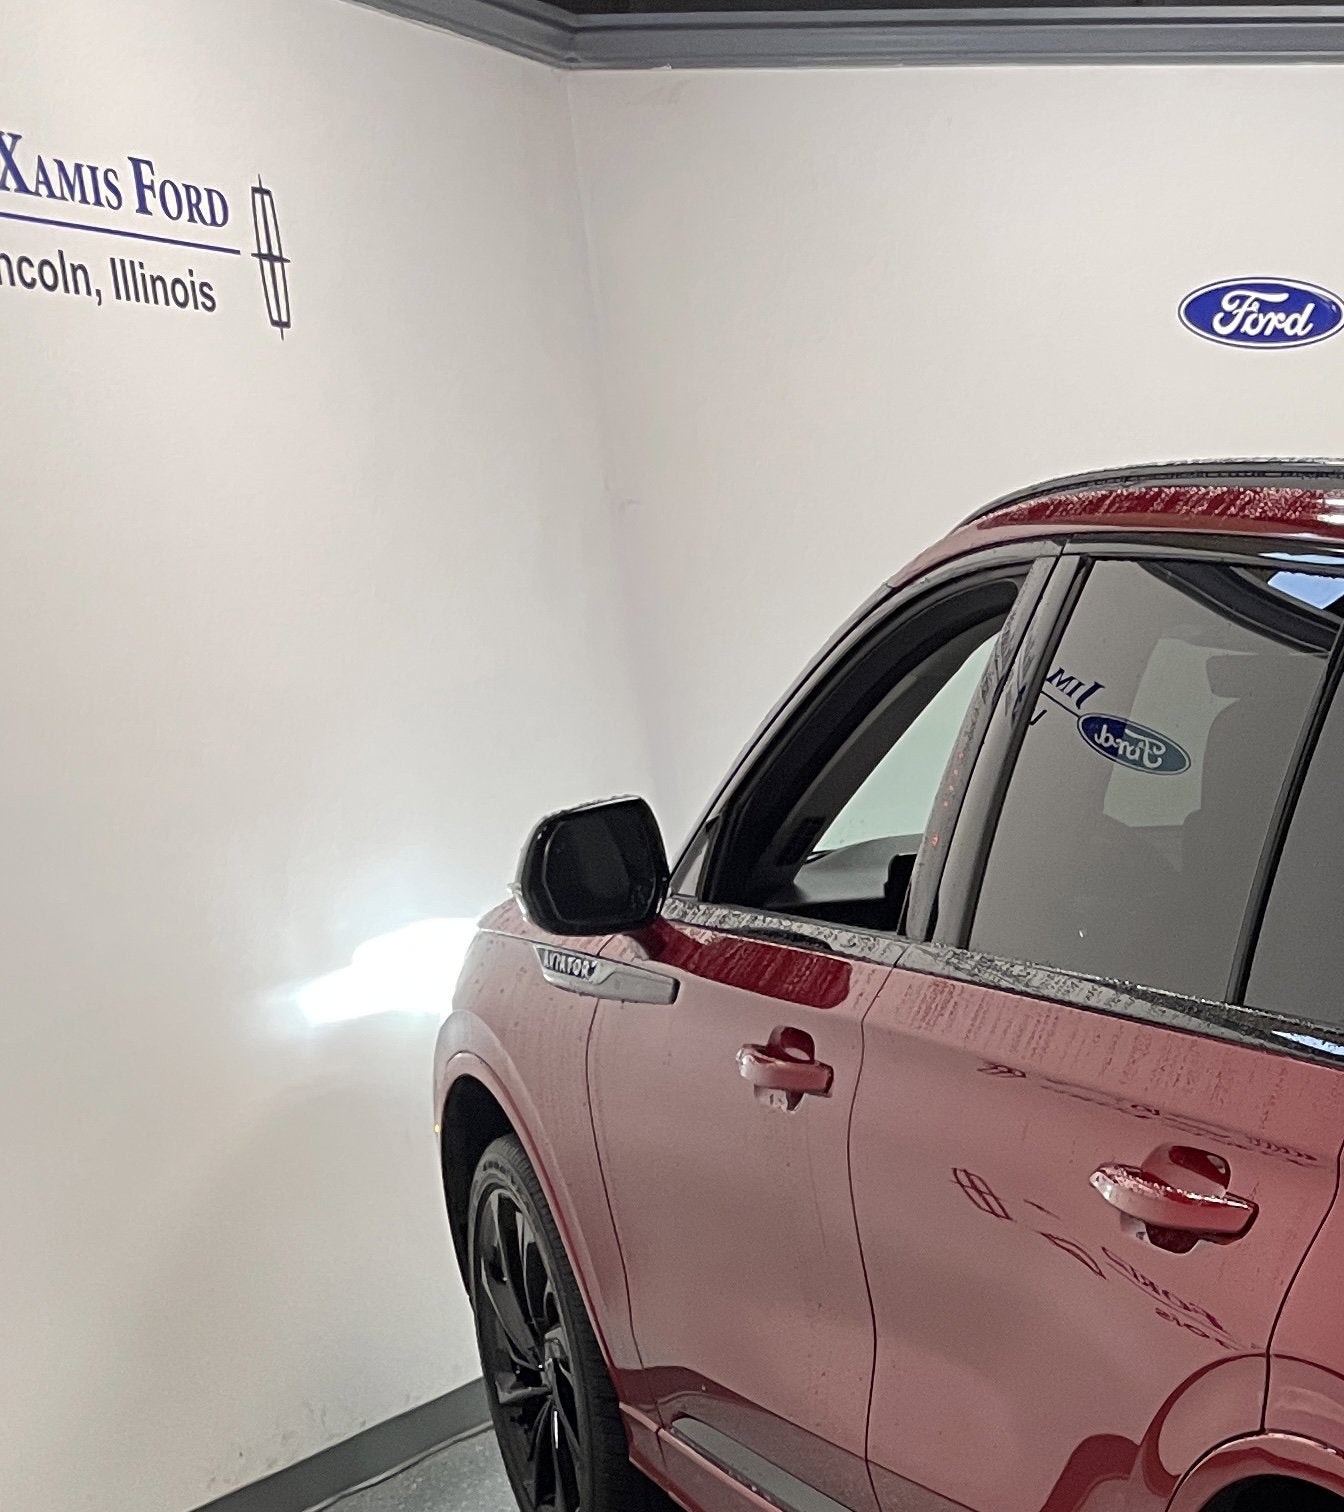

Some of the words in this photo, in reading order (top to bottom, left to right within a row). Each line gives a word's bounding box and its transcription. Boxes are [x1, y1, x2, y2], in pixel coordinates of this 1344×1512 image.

[127, 156, 229, 228] FORD
[0, 250, 102, 306] ncoln,
[110, 257, 216, 313] Illinois
[1212, 289, 1316, 336] Ford
